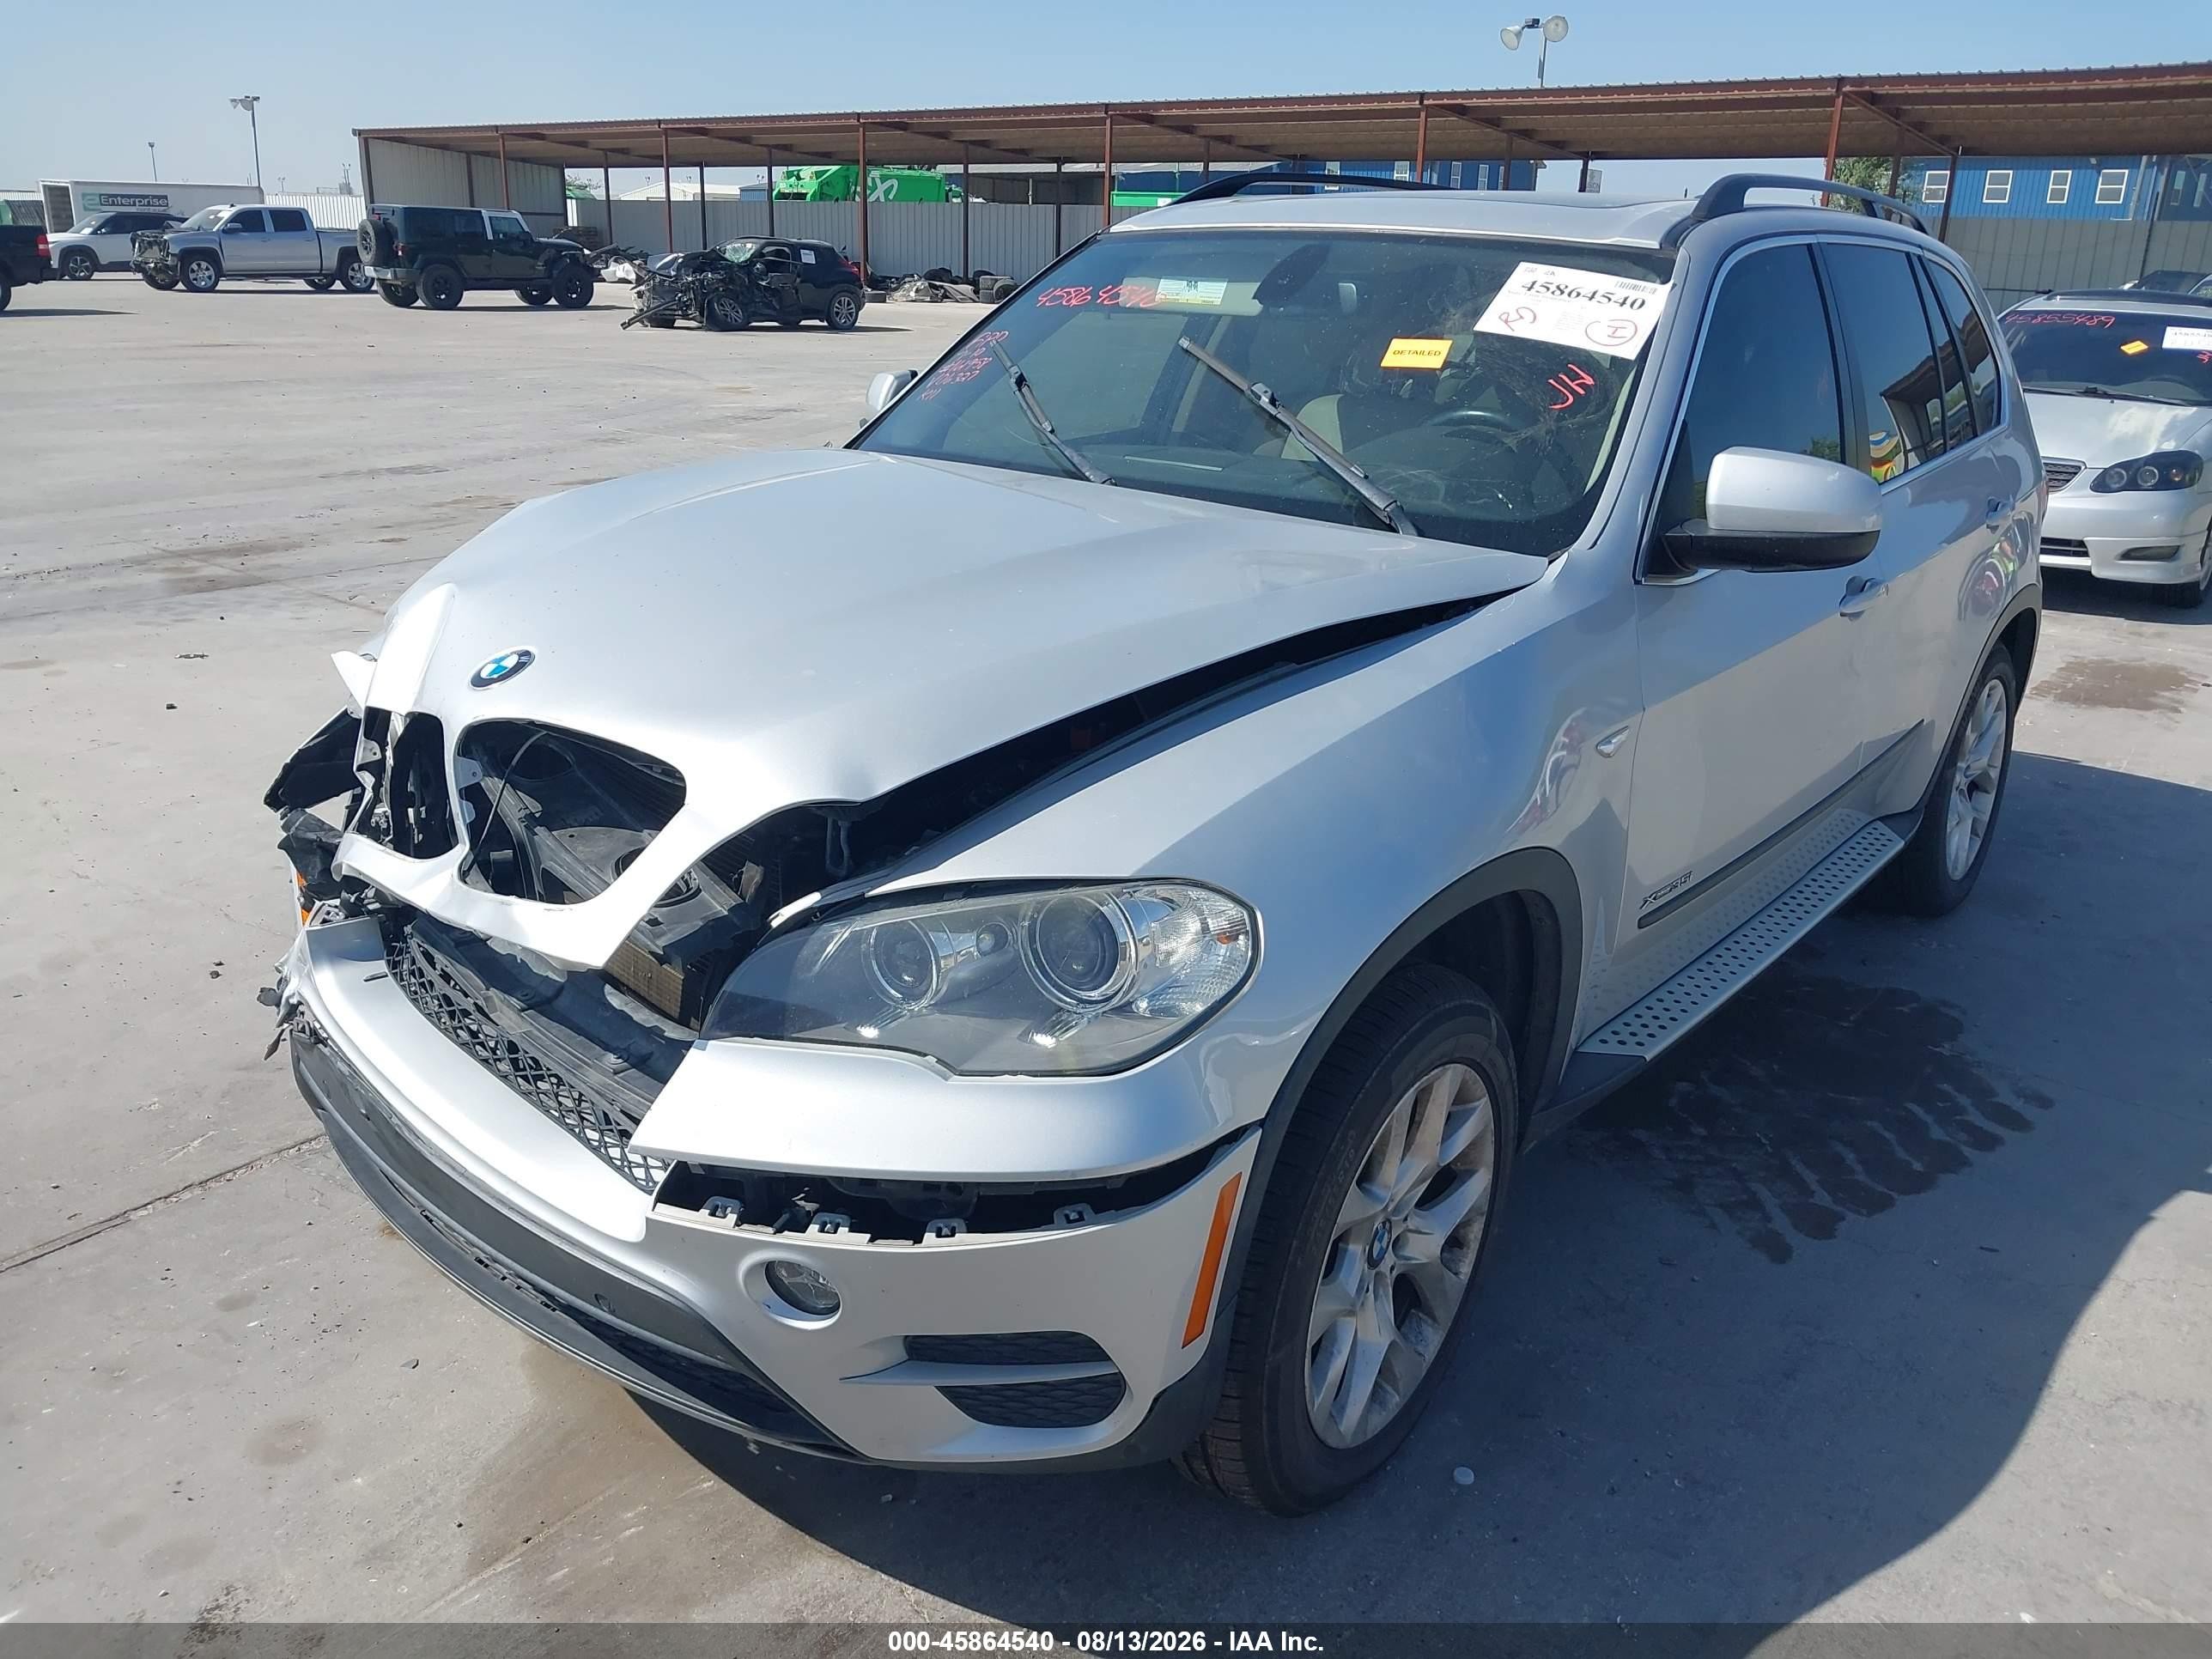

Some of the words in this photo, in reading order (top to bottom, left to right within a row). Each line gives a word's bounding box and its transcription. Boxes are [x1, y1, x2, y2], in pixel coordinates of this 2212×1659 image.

[100, 195, 168, 207] Enterprise
[1522, 280, 1646, 310] 45864540
[2004, 313, 2116, 329] 45855489
